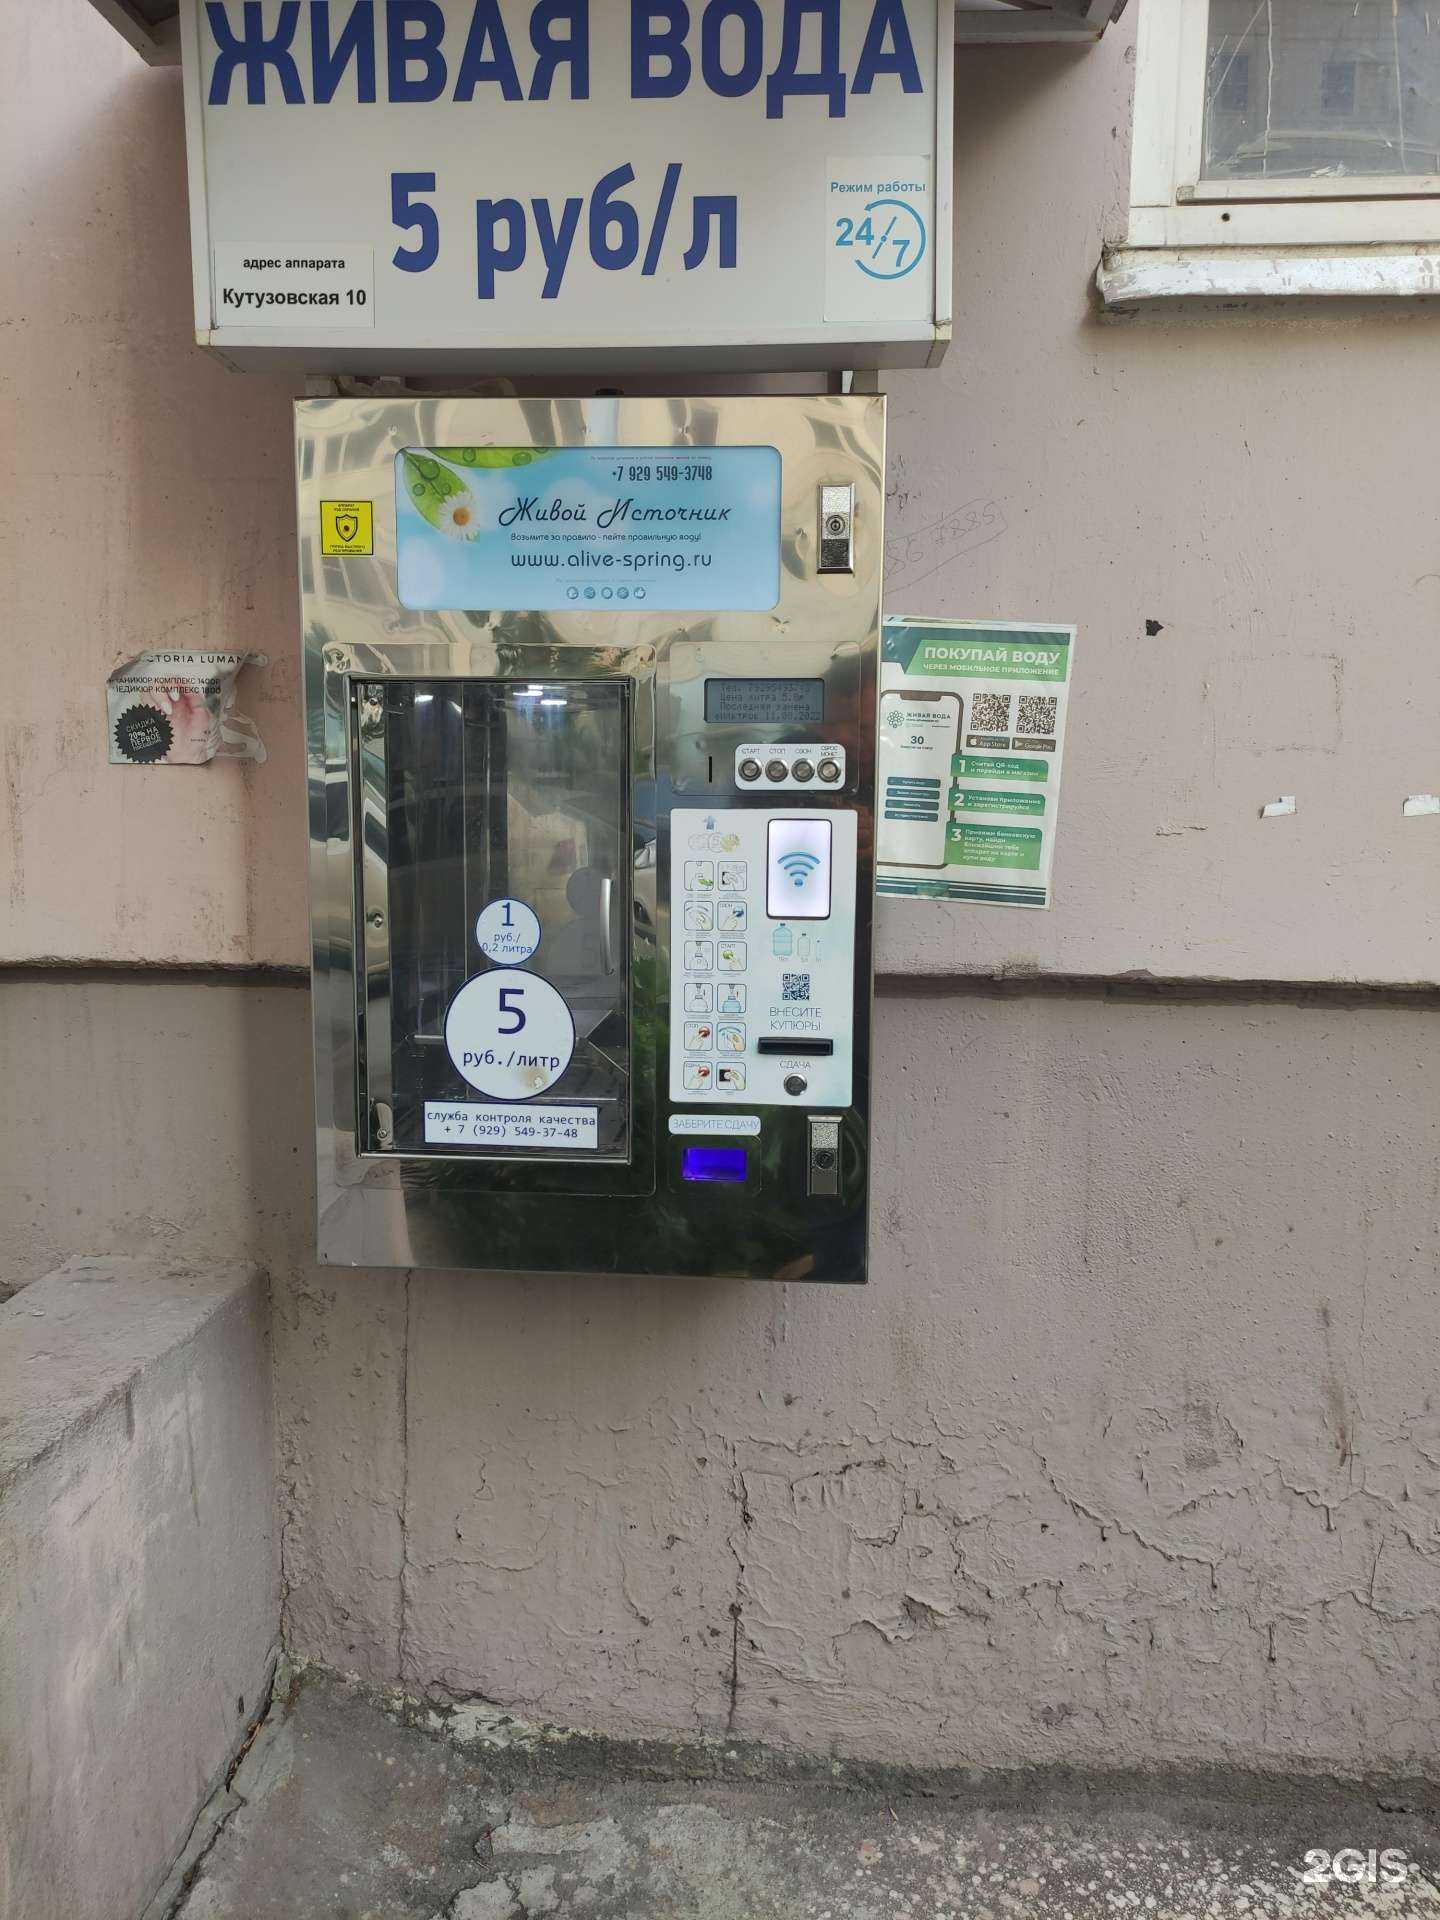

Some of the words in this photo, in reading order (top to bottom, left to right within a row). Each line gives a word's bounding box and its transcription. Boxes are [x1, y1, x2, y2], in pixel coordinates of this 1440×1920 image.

[207, 0, 589, 105] ЖИВАЯ
[630, 0, 923, 119] ВОДА
[831, 182, 872, 192] Режим
[877, 181, 926, 194] работы
[391, 171, 440, 272] 5
[477, 162, 738, 300] руб/л
[243, 258, 282, 270] адрес
[285, 258, 345, 270] аппарата
[223, 288, 340, 308] Кутузовская
[346, 289, 367, 305] 10
[629, 466, 651, 481] 929
[656, 466, 712, 480] 549-3748
[499, 497, 587, 527] Живой
[596, 498, 732, 529] Источник
[511, 533, 549, 541] Возьмите
[511, 550, 712, 572] www.alive-spring.ru
[146, 654, 194, 664] CTORIA
[924, 646, 1007, 662] ПОКУПАЙ
[1012, 650, 1060, 666] ВОДУ
[950, 664, 1000, 673] МОБИЛЬНОЕ
[1002, 666, 1060, 676] ПРИЛОЖЕНИЕ
[910, 736, 924, 744] 30
[959, 760, 966, 773] 1
[954, 793, 965, 806] 2
[951, 828, 962, 842] 3
[502, 902, 515, 927] 1
[494, 932, 521, 944] руб./
[482, 942, 498, 953] 0,2
[502, 944, 533, 956] литра
[498, 988, 527, 1035] 5
[770, 1007, 822, 1018] ВНЕСИТЕ
[770, 1021, 821, 1031] КУПЮРЫ
[463, 1050, 560, 1070] руб./литр
[780, 1060, 811, 1069] СДАЧА
[427, 1111, 468, 1124] служба
[475, 1113, 532, 1125] контроля
[539, 1114, 596, 1126] качества
[673, 1119, 723, 1129] ЗАБЕРИТЕ
[725, 1120, 760, 1130] СДАЧУ
[458, 1125, 465, 1134] 7
[473, 1125, 506, 1138] (929)
[515, 1127, 578, 1138] 549-37-48
